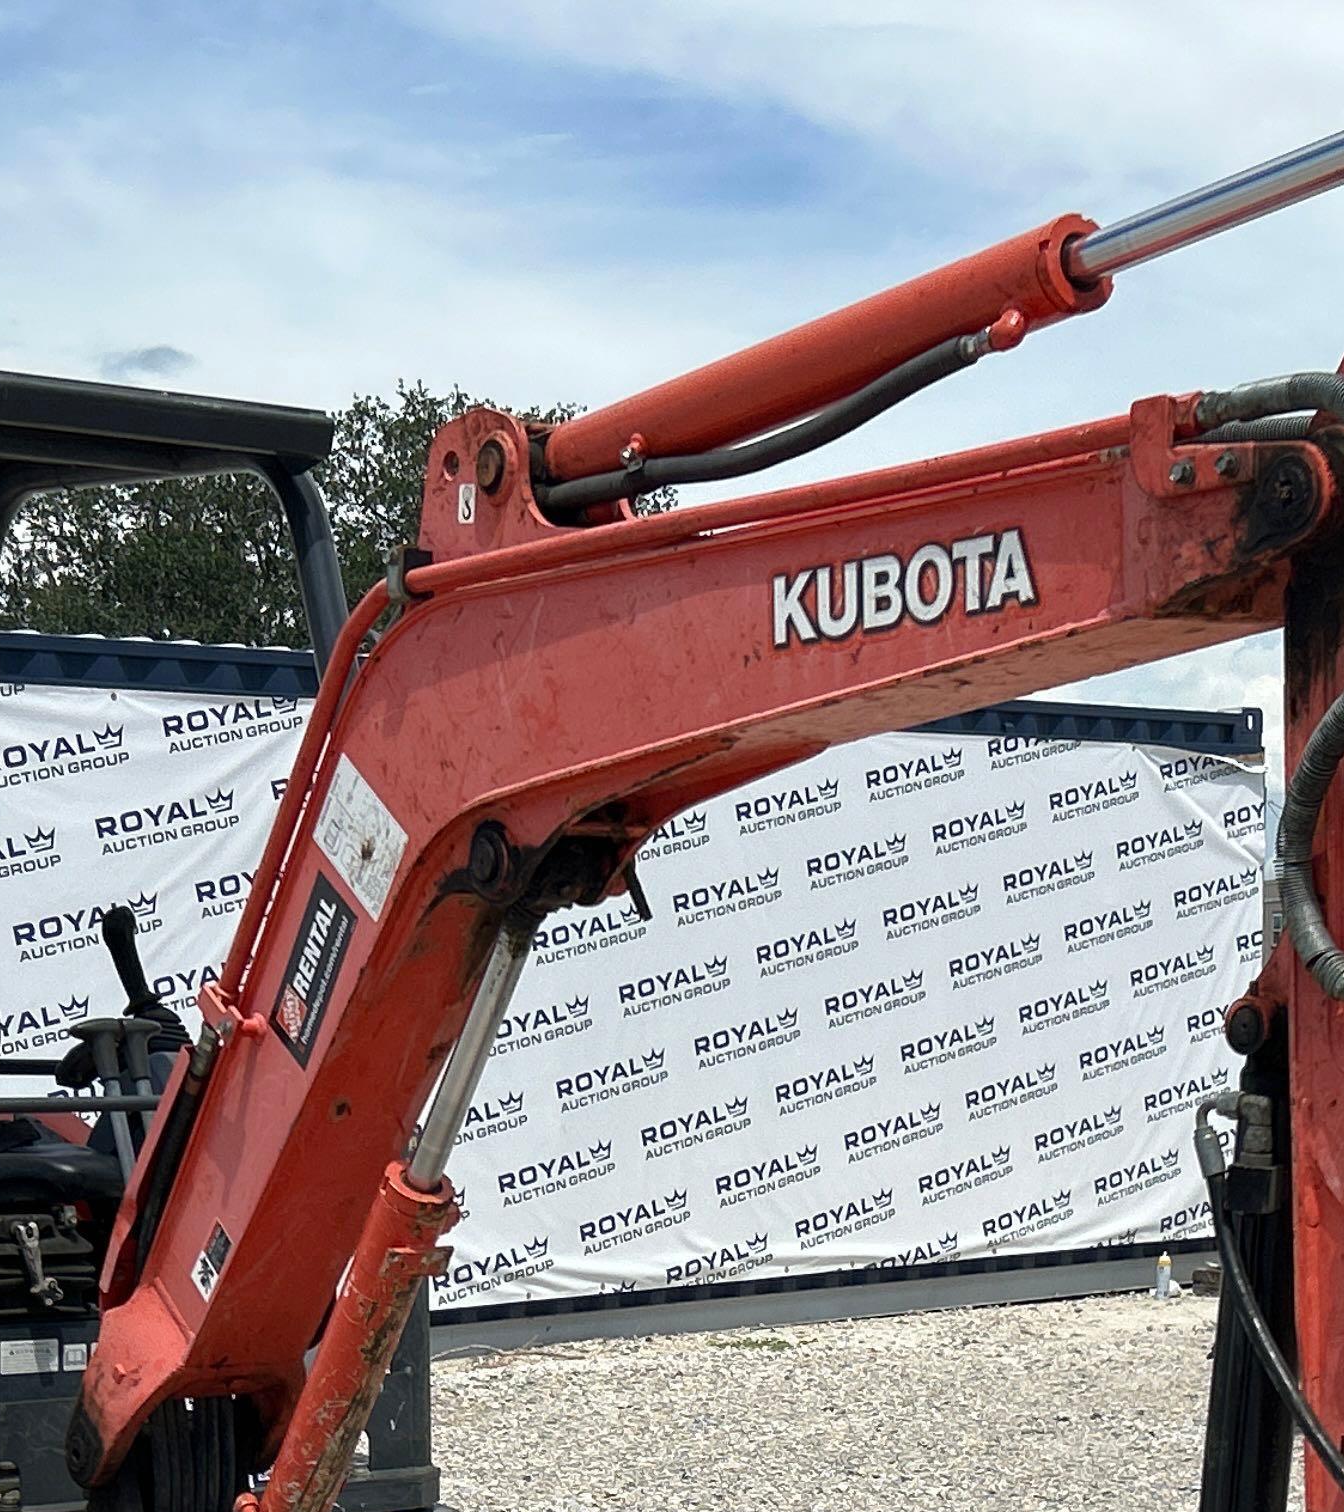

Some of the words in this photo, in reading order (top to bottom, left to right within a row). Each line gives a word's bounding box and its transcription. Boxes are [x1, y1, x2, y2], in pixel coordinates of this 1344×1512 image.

[773, 528, 1036, 646] KUBOTA
[163, 698, 272, 737] ROYAL
[169, 728, 242, 753] AUCTION
[247, 715, 303, 737] GROUP
[68, 751, 129, 774] GROUP
[865, 752, 944, 788] ROYAL
[735, 784, 819, 821] ROYAL
[1049, 775, 1120, 810] ROYAL
[94, 795, 208, 838] ROYAL
[102, 828, 177, 855] AUCTION
[180, 815, 238, 837] GROUP
[739, 812, 795, 835] AUCTION
[797, 801, 841, 820] GROUP
[932, 806, 1007, 842] ROYAL
[663, 836, 709, 856] GROUP
[806, 838, 887, 876] ROYAL
[1115, 824, 1185, 858] ROYAL
[672, 873, 759, 912] ROYAL
[1002, 855, 1075, 891] ROYAL
[1173, 872, 1241, 907] ROYAL
[677, 902, 735, 927] AUCTION
[737, 890, 782, 910] GROUP
[882, 888, 960, 927] ROYAL
[1064, 904, 1134, 941] ROYAL
[20, 933, 99, 962] AUCTION
[292, 899, 337, 1001] RENTAL
[531, 909, 622, 951] ROYAL
[536, 940, 597, 966] AUCTION
[599, 927, 646, 948] GROUP
[755, 924, 836, 964] ROYAL
[759, 953, 814, 977] AUCTION
[816, 940, 858, 960] GROUP
[948, 938, 1022, 977] ROYAL
[1129, 950, 1198, 986] ROYAL
[618, 961, 706, 1003] ROYAL
[622, 991, 681, 1017] AUCTION
[684, 978, 729, 999] GROUP
[824, 975, 904, 1015] ROYAL
[1018, 984, 1090, 1022] ROYAL
[544, 1019, 592, 1041] GROUP
[694, 1013, 779, 1055] ROYAL
[698, 1043, 755, 1069] AUCTION
[757, 1029, 801, 1050] GROUP
[900, 1021, 977, 1061] ROYAL
[1079, 1031, 1148, 1069] ROYAL
[555, 1054, 644, 1098] ROYAL
[560, 1085, 619, 1113] AUCTION
[622, 1070, 667, 1093] GROUP
[774, 1061, 855, 1102] ROYAL
[965, 1068, 1038, 1108] ROYAL
[1144, 1075, 1212, 1111] ROYAL
[477, 1115, 528, 1139] GROUP
[640, 1102, 727, 1146] ROYAL
[645, 1132, 703, 1160] AUCTION
[705, 1118, 750, 1140] GROUP
[843, 1108, 922, 1150] ROYAL
[1034, 1111, 1105, 1151] ROYAL
[498, 1146, 591, 1193] ROYAL
[503, 1178, 565, 1207] AUCTION
[568, 1162, 616, 1185] GROUP
[715, 1151, 798, 1194] ROYAL
[720, 1180, 775, 1208] AUCTION
[777, 1165, 820, 1187] GROUP
[918, 1151, 993, 1193] ROYAL
[1093, 1154, 1162, 1194] ROYAL
[578, 1195, 666, 1242] ROYAL
[584, 1227, 642, 1255] AUCTION
[645, 1210, 690, 1234] GROUP
[795, 1194, 874, 1238] ROYAL
[982, 1195, 1054, 1236] ROYAL
[431, 1244, 527, 1291] ROYAL
[438, 1275, 501, 1305] AUCTION
[504, 1258, 553, 1282] GROUP
[666, 1243, 750, 1285] ROYAL
[728, 1253, 773, 1278] GROUP
